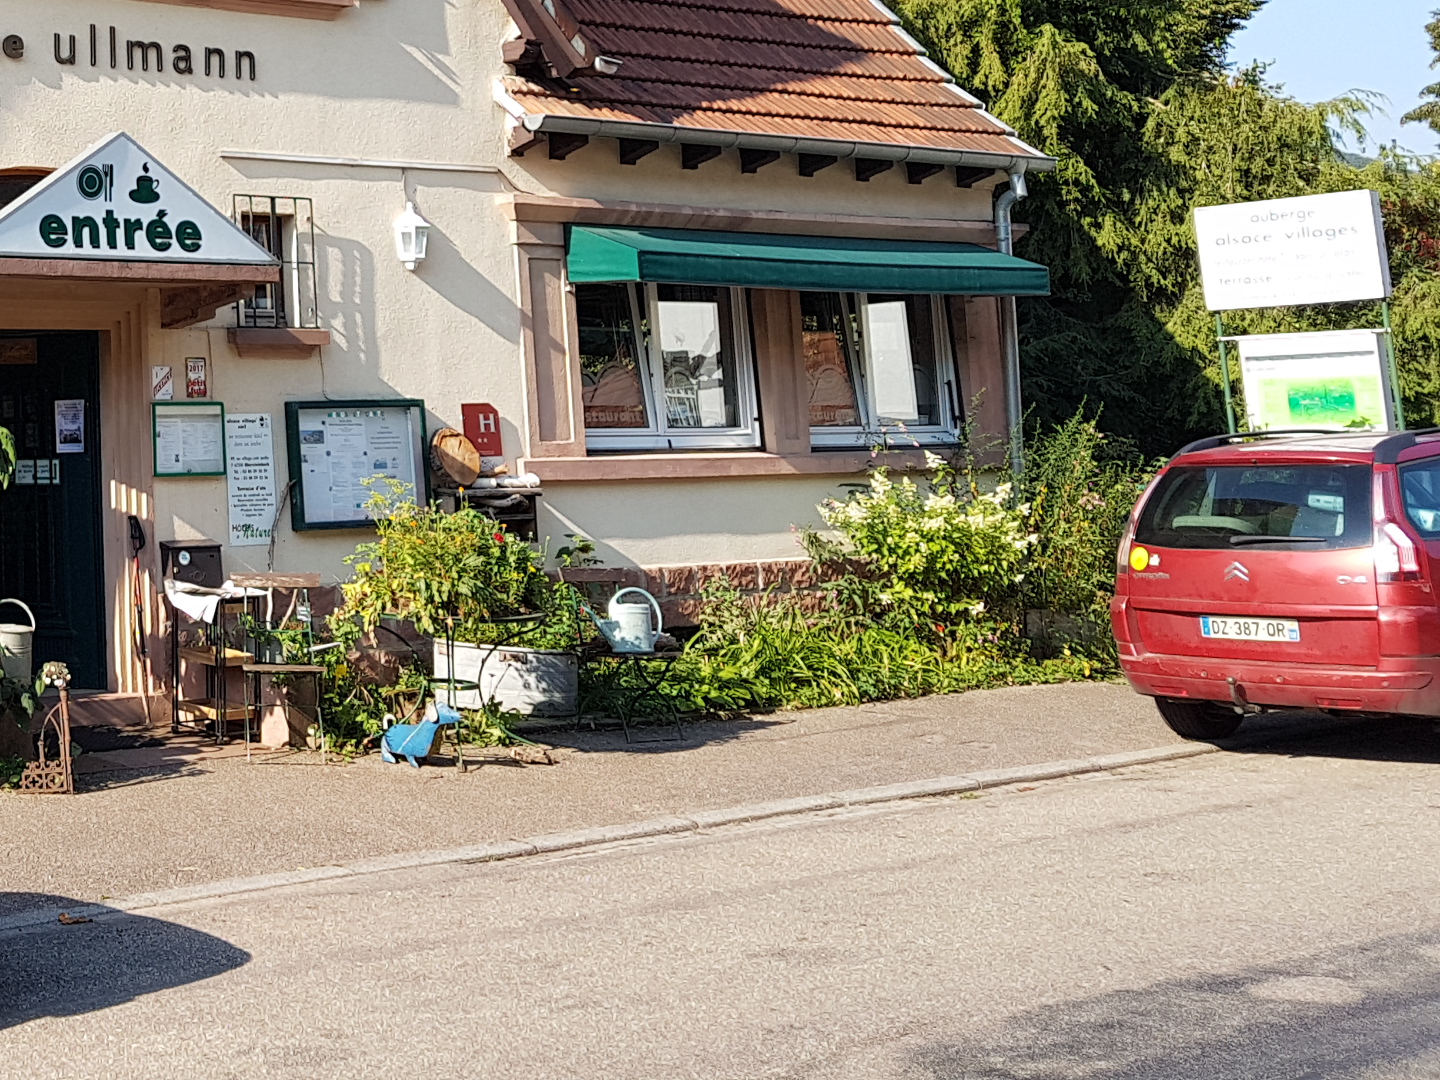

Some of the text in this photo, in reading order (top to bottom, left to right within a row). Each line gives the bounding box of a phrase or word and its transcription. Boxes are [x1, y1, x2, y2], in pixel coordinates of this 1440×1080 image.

[53, 23, 257, 81] ullmann
[1250, 209, 1316, 223] auberge
[39, 209, 202, 253] entrée
[1215, 225, 1359, 246] alsace villages
[478, 413, 496, 433] H
[1337, 575, 1369, 585] C4
